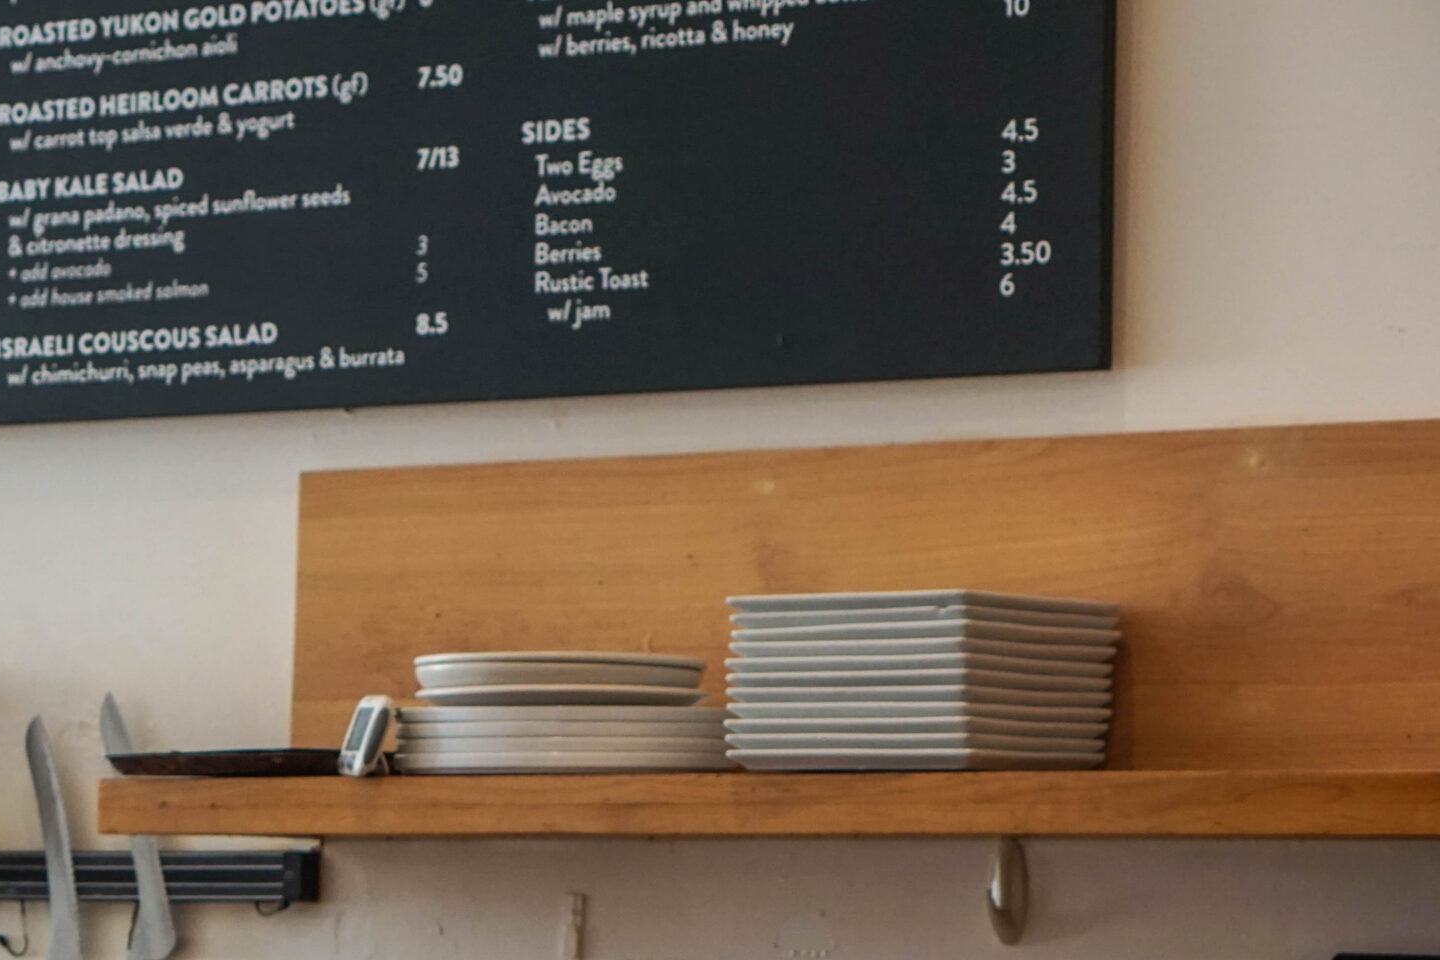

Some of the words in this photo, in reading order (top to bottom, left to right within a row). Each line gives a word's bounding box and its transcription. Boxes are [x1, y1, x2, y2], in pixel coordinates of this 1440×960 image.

[100, 10, 179, 37] YUKON
[183, 4, 246, 30] GOLD
[251, 0, 365, 23] POTATOES
[539, 6, 562, 28] w/
[567, 1, 624, 31] maple
[629, 3, 682, 27] syrup
[686, 0, 722, 16] and
[1005, 0, 1030, 16] 10
[538, 35, 562, 57] w/
[566, 31, 636, 56] berries,
[641, 27, 705, 48] ricotta
[711, 20, 727, 43] &
[733, 19, 794, 45] honey
[35, 39, 198, 74] anchovy-cornichon
[201, 33, 237, 57] aioli
[419, 64, 463, 88] 7.50
[100, 86, 219, 116] HEIRLOOM
[223, 75, 328, 106] CARROTS
[332, 72, 368, 104] (gf)
[34, 130, 84, 150] carrot
[88, 129, 118, 150] top
[122, 120, 161, 143] salsa
[165, 115, 213, 138] verde
[217, 112, 232, 134] &
[236, 112, 294, 139] yogurt
[522, 117, 590, 144] SIDES
[1002, 118, 1038, 141] 4.5
[418, 146, 459, 170] 7/13
[535, 154, 573, 176] Two
[578, 151, 623, 184] Eggs
[1002, 150, 1015, 173] 3
[55, 173, 108, 197] KALE
[112, 168, 183, 194] SALAD
[534, 179, 616, 205] Avocado
[1001, 180, 1037, 203] 4.5
[33, 211, 80, 237] grana
[83, 201, 150, 230] padano,
[154, 194, 208, 225] spiced
[212, 190, 297, 214] sunflower
[302, 184, 350, 208] seeds
[1000, 212, 1016, 234] 4
[535, 213, 593, 236] Bacon
[8, 235, 23, 257] &
[26, 235, 110, 255] citronette
[114, 226, 185, 253] dressing
[417, 235, 428, 255] 3
[535, 241, 602, 265] Berries
[1001, 240, 1051, 266] 3.50
[20, 262, 48, 282] add
[51, 258, 112, 280] avocado
[416, 262, 428, 283] 5
[535, 270, 594, 293] Rustic
[599, 267, 648, 290] Toast
[20, 288, 48, 308] add
[97, 282, 153, 303] smoked
[156, 279, 209, 300] salmon
[1000, 273, 1015, 296] 6
[416, 312, 448, 335] 8.5
[78, 327, 200, 355] COUSCOUS
[205, 322, 278, 347] SALAD
[31, 360, 134, 385] chimichurri,
[138, 364, 178, 384] snap
[181, 361, 225, 383] peas,
[229, 356, 315, 380] asparagus
[319, 347, 335, 369] &
[339, 347, 405, 368] burrata
